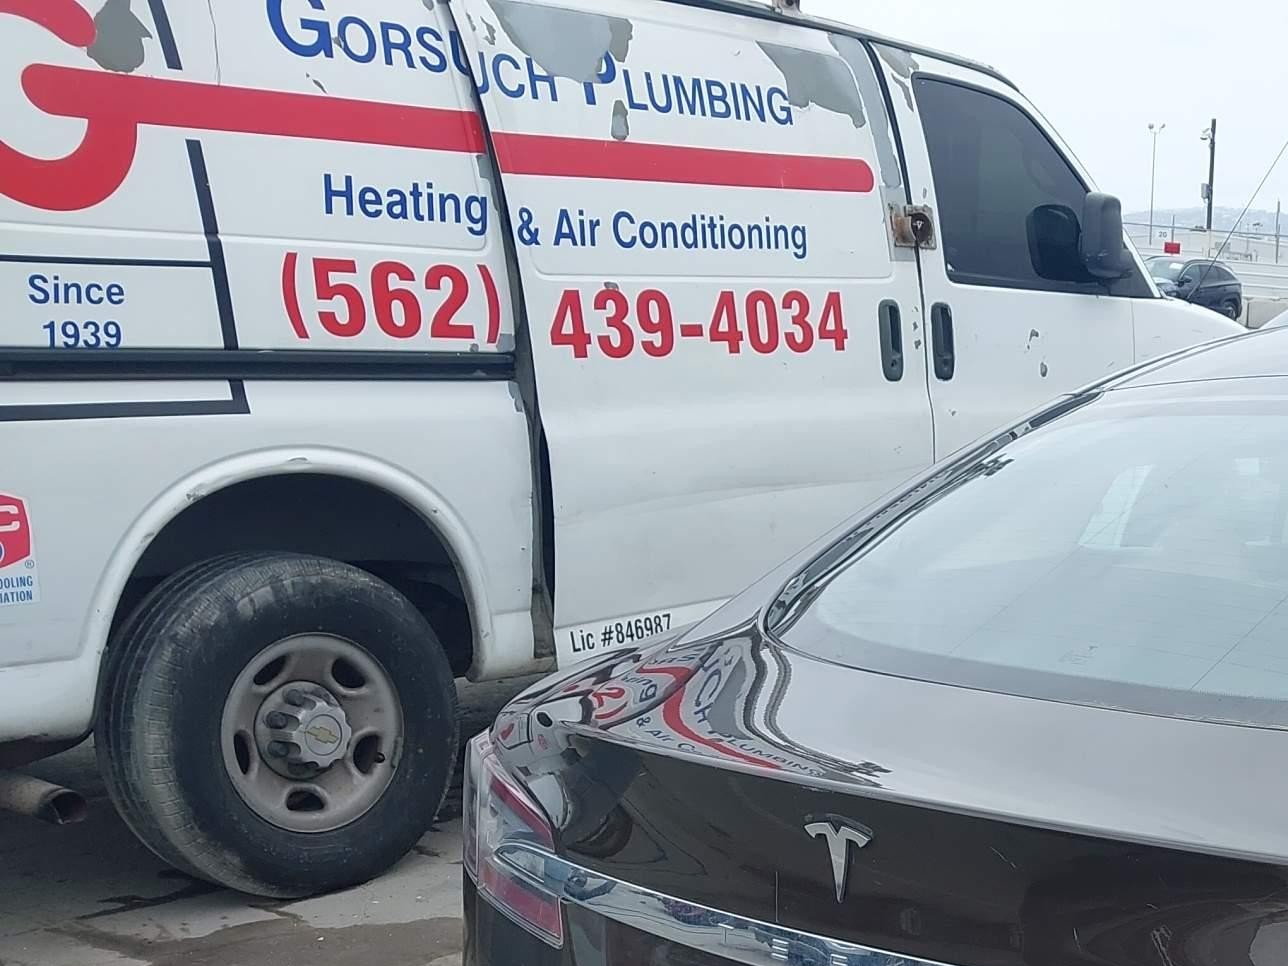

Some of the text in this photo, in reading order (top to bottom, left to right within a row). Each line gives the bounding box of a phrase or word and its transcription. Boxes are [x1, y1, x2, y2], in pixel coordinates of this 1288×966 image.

[322, 173, 808, 260] Heating & Air Conditioning
[27, 273, 126, 306] Since
[281, 251, 849, 359] (562) 439-4034
[42, 320, 123, 349] 1939
[569, 613, 671, 653] Lic #846987
